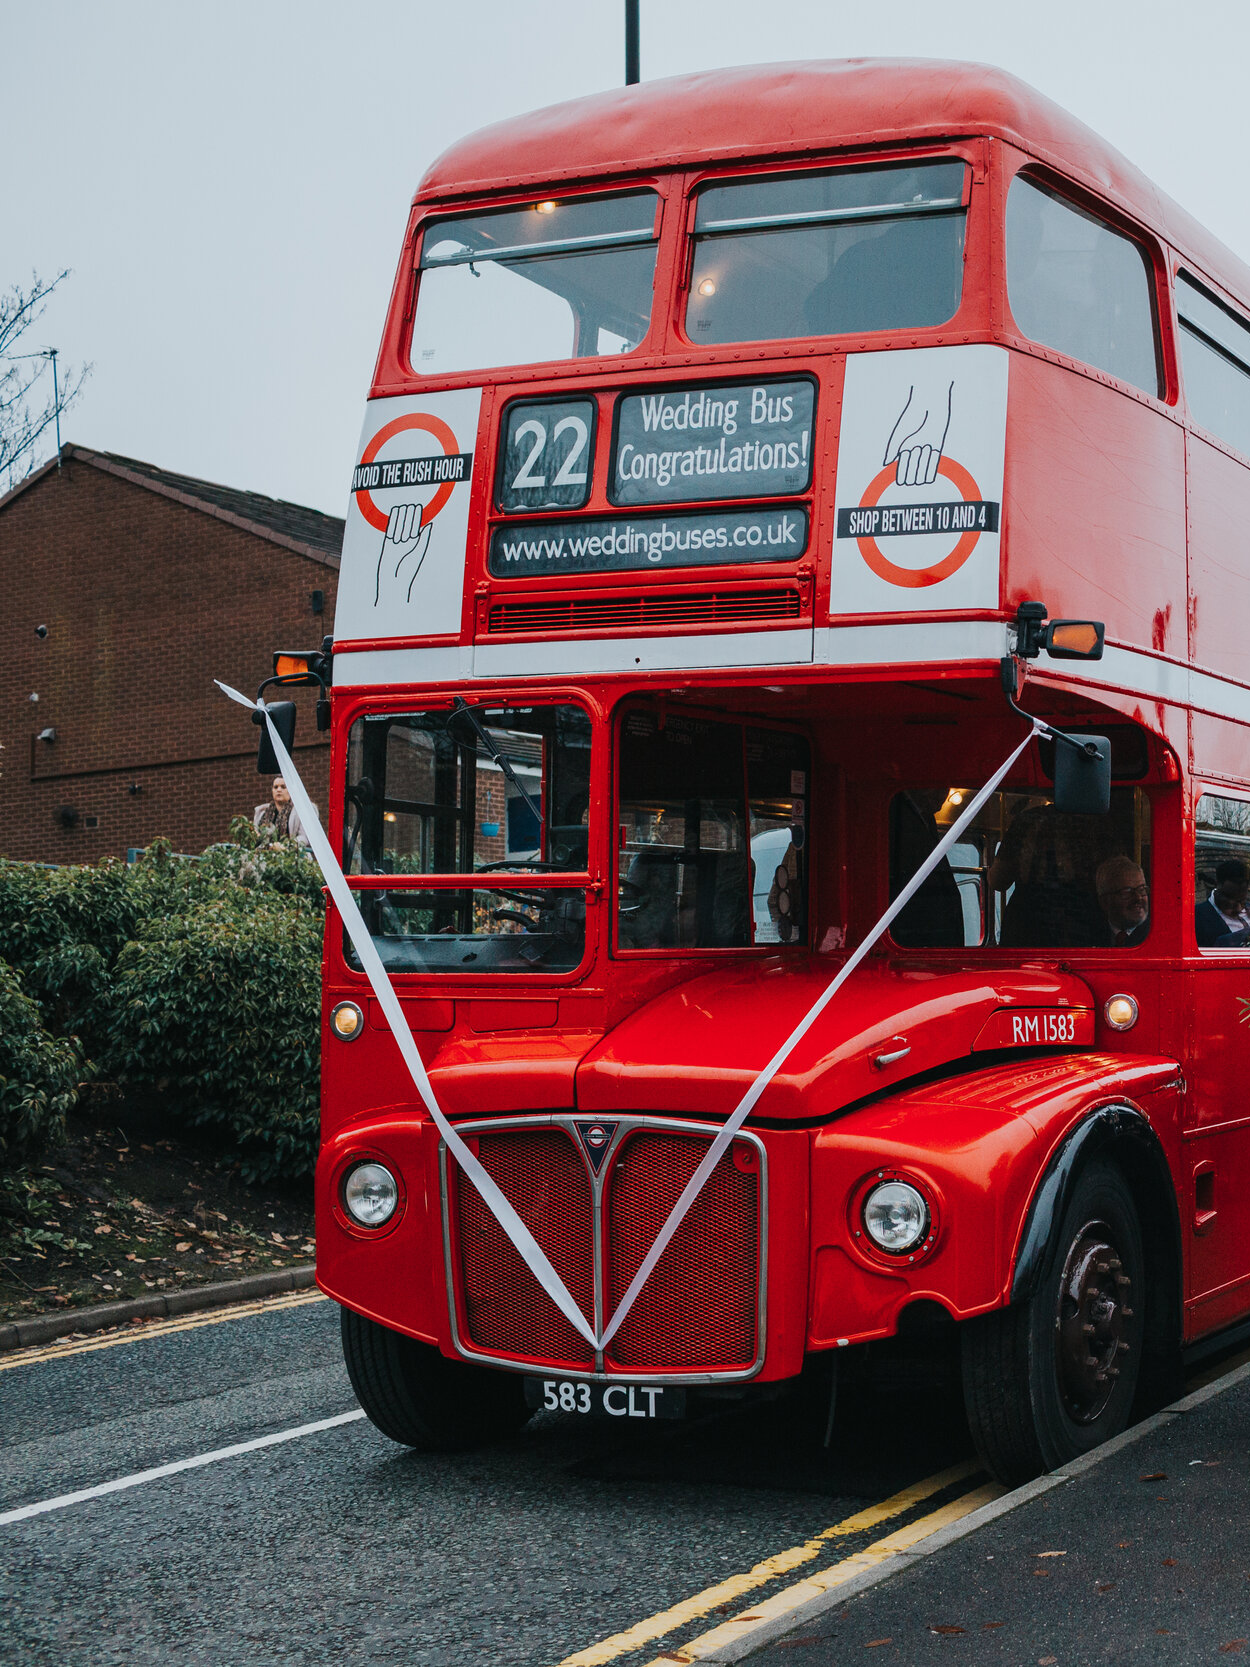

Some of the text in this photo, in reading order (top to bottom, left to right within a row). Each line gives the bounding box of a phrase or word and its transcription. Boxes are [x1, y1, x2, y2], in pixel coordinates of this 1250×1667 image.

[641, 387, 793, 435] Wedding Bus
[351, 457, 464, 490] AVOID THE RUSH HOUR
[511, 416, 588, 489] 22
[618, 430, 809, 486] Congratulations!
[503, 515, 796, 562] www.weddingbuses.co.uk
[850, 505, 986, 534] SHOP BETWEEN 10 AND 4
[543, 1381, 664, 1417] 583 CLT
